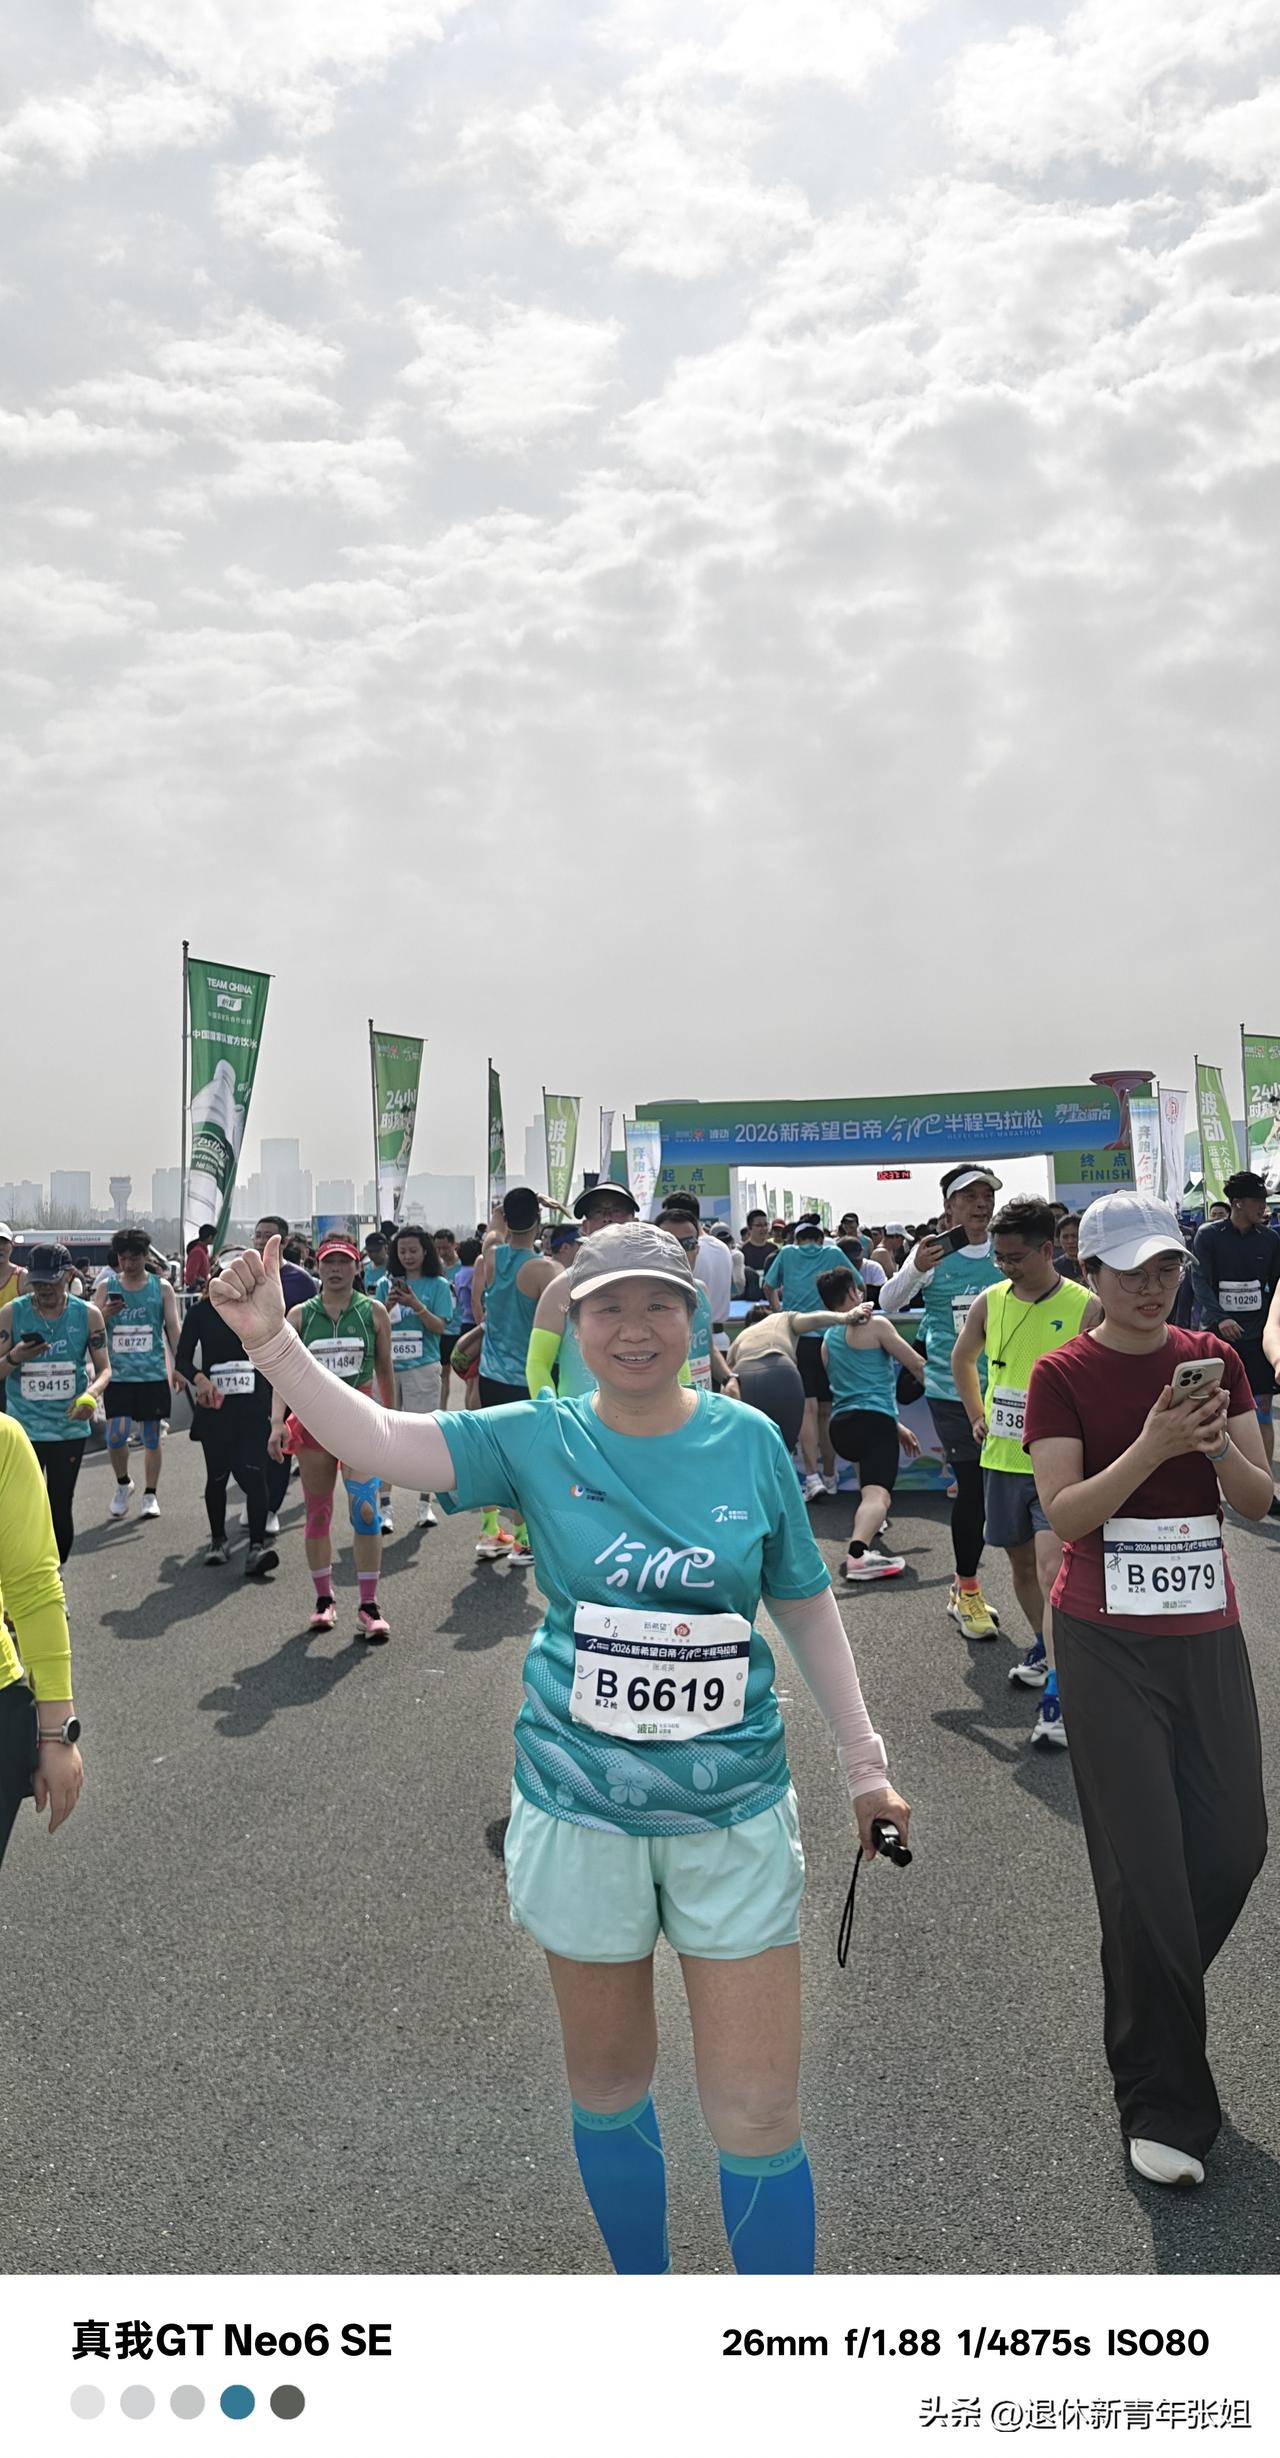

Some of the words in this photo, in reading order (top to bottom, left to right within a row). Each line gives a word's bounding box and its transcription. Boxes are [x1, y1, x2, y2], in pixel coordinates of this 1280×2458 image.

[207, 977, 228, 989] TEAM
[228, 982, 252, 995] CHINA
[1201, 1091, 1224, 1142] 波动
[735, 1108, 1043, 1143] 2026新希望白帝合肥半程马拉松
[548, 1120, 567, 1168] 波动
[1081, 1152, 1127, 1167] 终点
[662, 1168, 704, 1182] 起点
[1081, 1169, 1130, 1181] FINISH
[662, 1184, 705, 1194] START
[124, 1337, 147, 1346] 8727
[393, 1344, 416, 1354] 6653
[326, 1356, 355, 1369] 11484
[28, 1381, 36, 1390] C
[38, 1380, 70, 1392] 9415
[225, 1376, 250, 1387] 7142
[996, 1410, 1003, 1422] B
[1006, 1413, 1024, 1429] 38
[594, 1531, 716, 1593] 合肥
[1128, 1564, 1145, 1585] B
[1152, 1564, 1215, 1593] 6979
[596, 1668, 618, 1699] B
[627, 1676, 725, 1712] 6619
[637, 1723, 658, 1735] 波动
